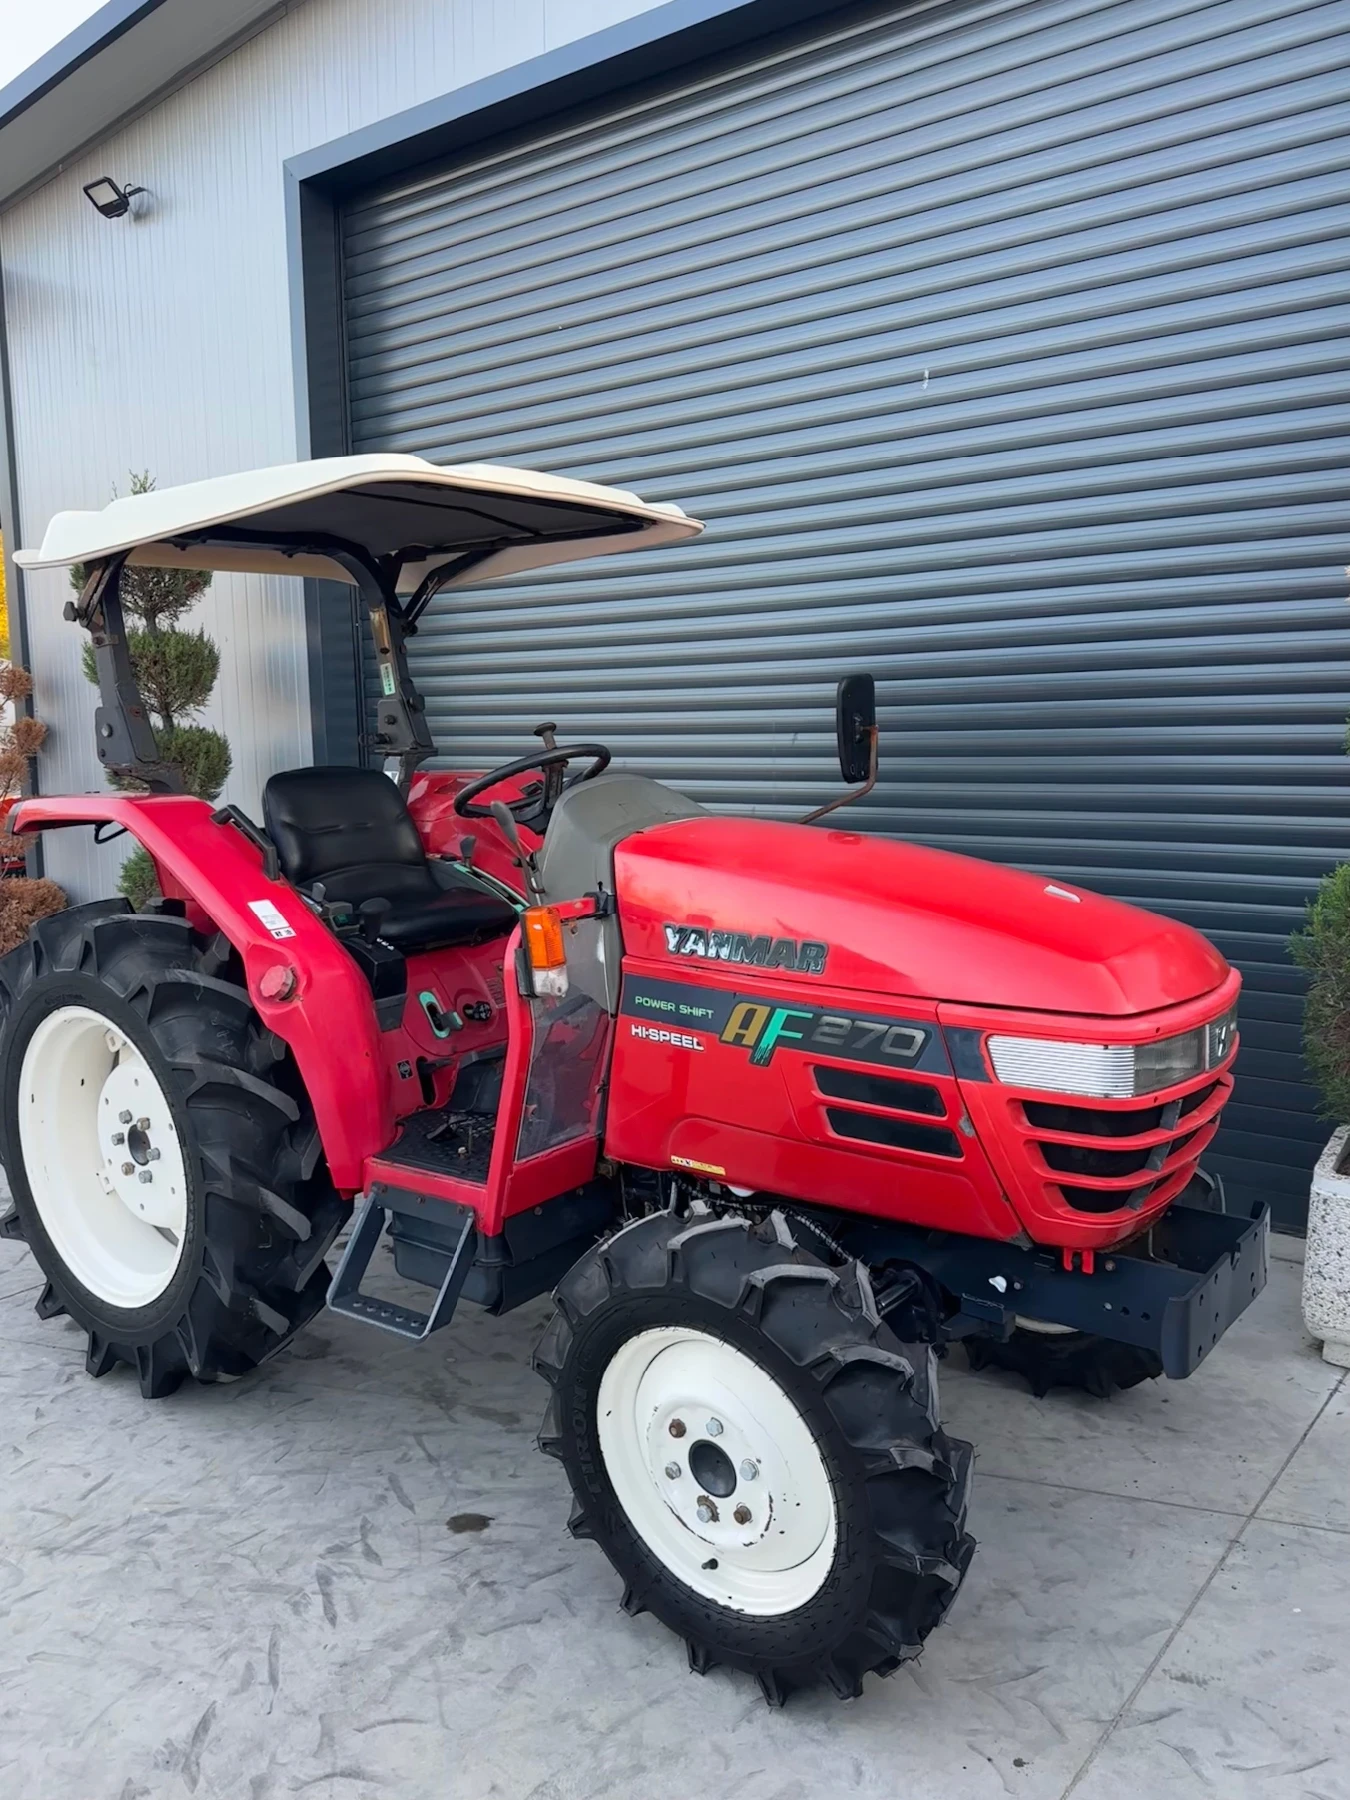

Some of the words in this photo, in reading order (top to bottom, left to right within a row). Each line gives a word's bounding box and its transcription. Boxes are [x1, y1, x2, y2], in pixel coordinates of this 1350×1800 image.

[664, 921, 829, 974] YANMAR
[635, 995, 676, 1012] POWER
[678, 1003, 714, 1019] SHIFT
